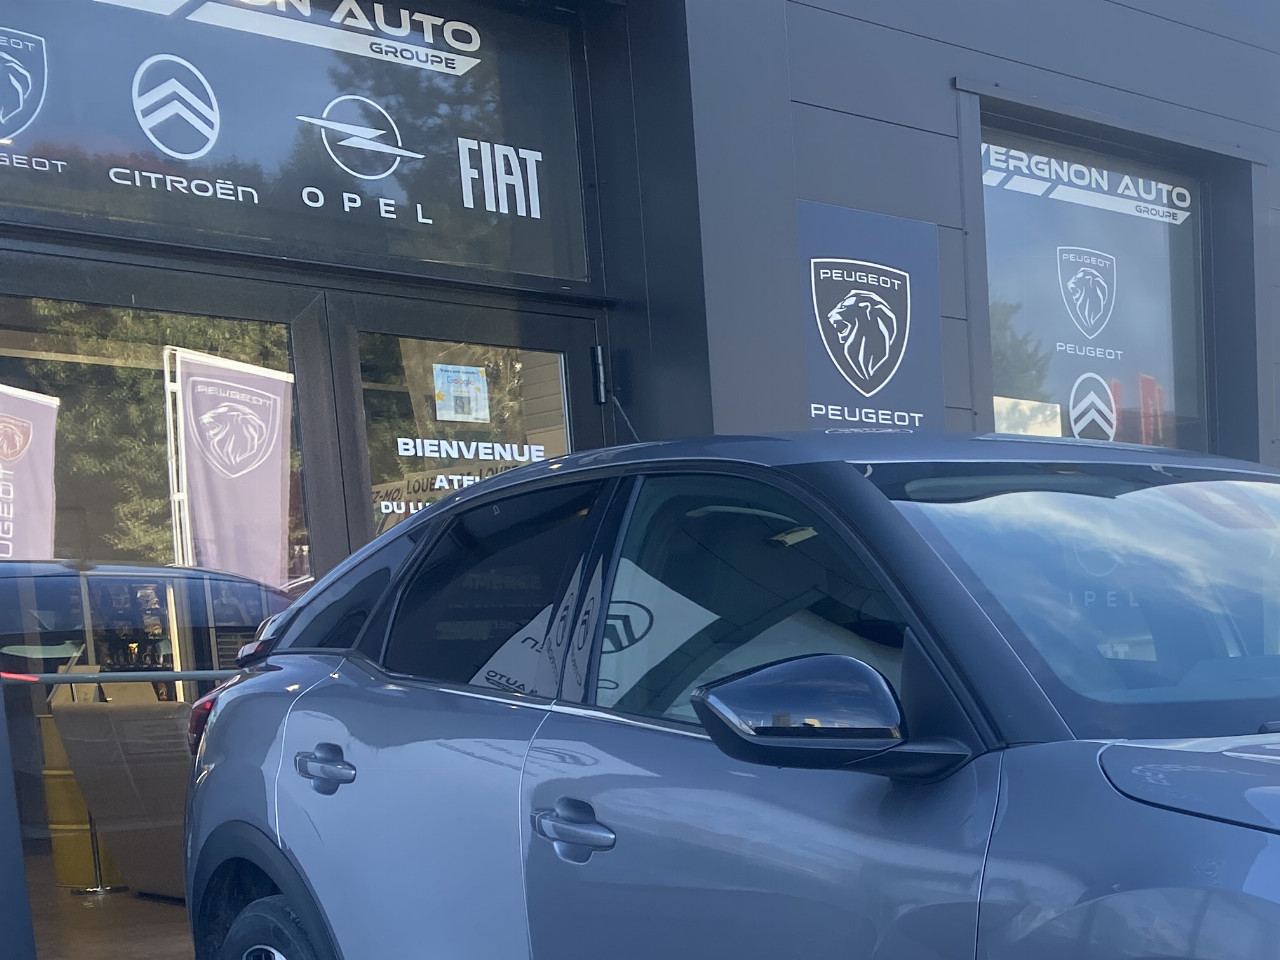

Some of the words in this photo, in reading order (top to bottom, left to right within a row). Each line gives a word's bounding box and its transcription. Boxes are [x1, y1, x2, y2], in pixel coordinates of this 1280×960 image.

[329, 0, 481, 51] AUTO
[369, 42, 457, 70] GROUPE
[458, 137, 543, 219] FIAT
[1117, 174, 1191, 208] AUTO
[301, 186, 433, 225] OPEL
[1135, 205, 1178, 221] GROUPE
[1062, 253, 1111, 269] PEUGEOT
[820, 269, 902, 291] PEUGEOT
[1056, 342, 1123, 361] PEUGEOT
[810, 403, 924, 427] PEUGEOT
[397, 438, 545, 463] BIENVENUE
[380, 500, 406, 514] DU
